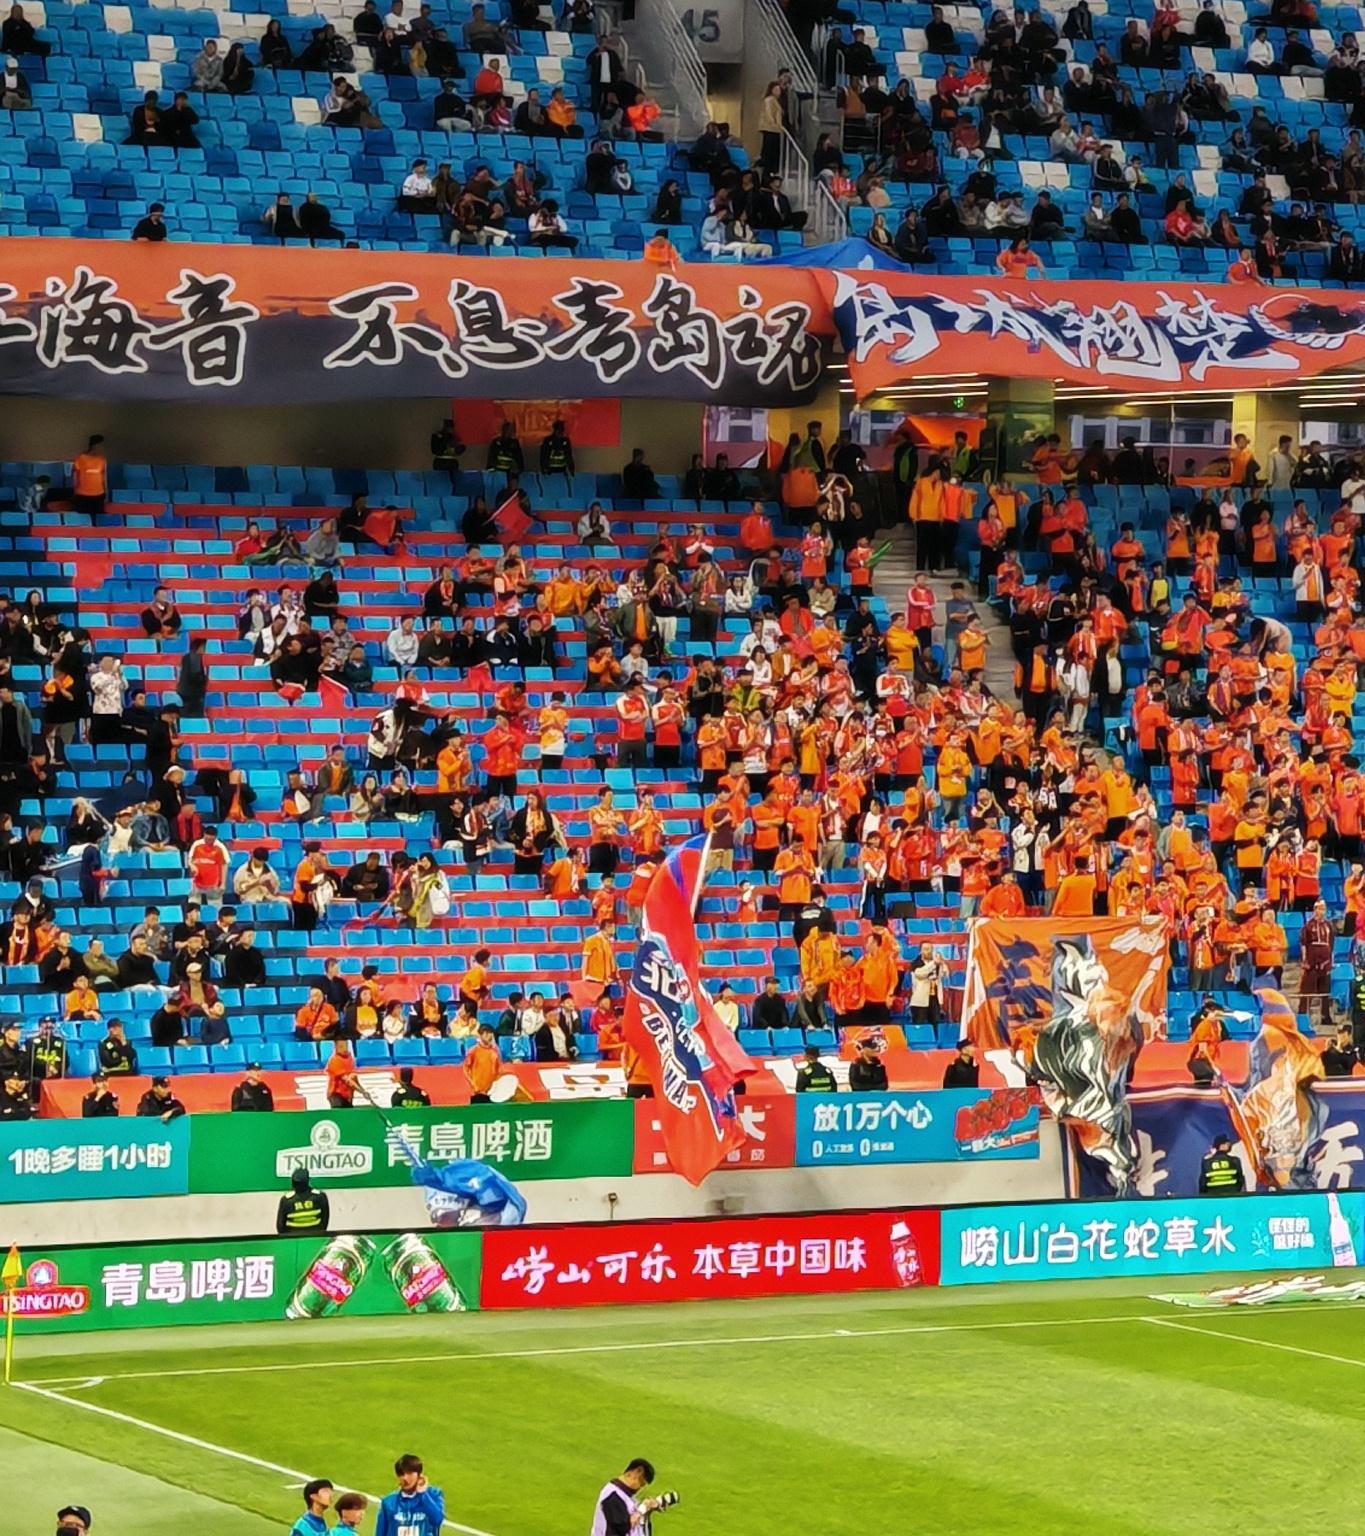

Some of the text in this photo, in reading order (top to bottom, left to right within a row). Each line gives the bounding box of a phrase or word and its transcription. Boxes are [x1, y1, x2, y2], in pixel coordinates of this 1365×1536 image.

[813, 1099, 933, 1132] 放1万个心
[8, 1141, 173, 1175] 1晚多睡1小时
[283, 1151, 367, 1172] TSINGTAO
[960, 1216, 1235, 1267] 崂山白花蛇草水
[501, 1243, 677, 1295] 崂山可乐
[691, 1237, 868, 1280] 本草中国味
